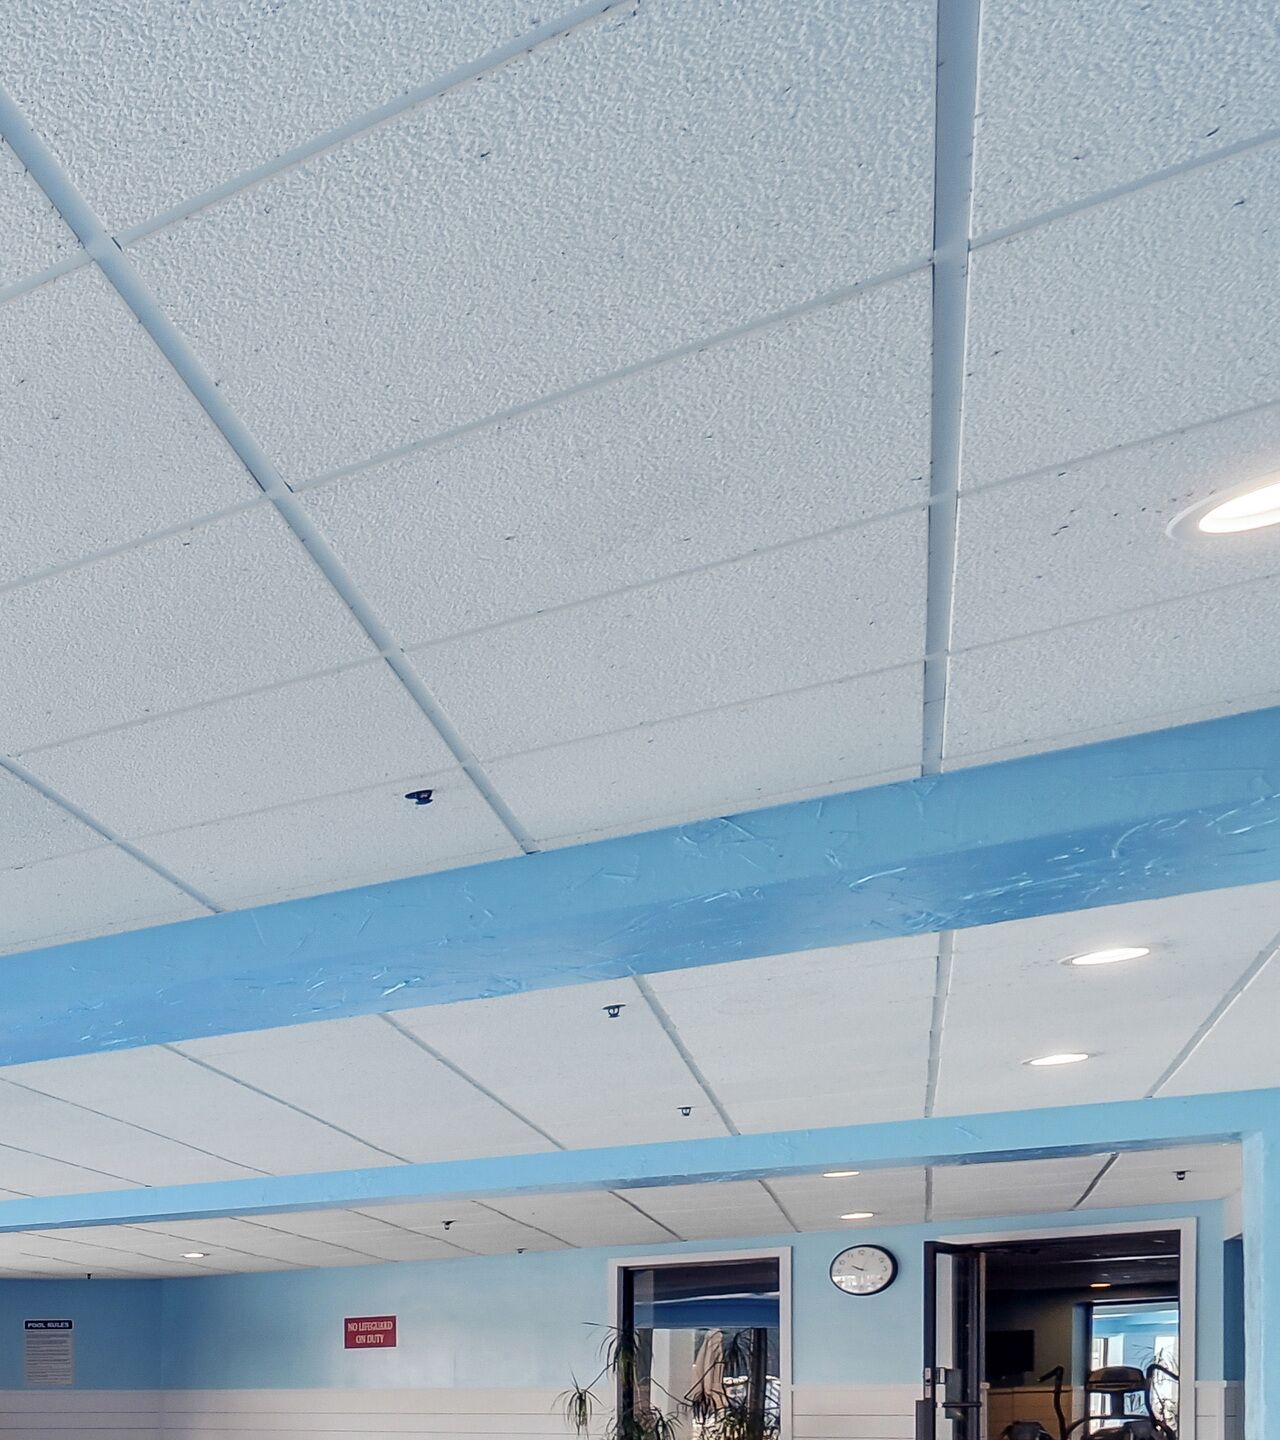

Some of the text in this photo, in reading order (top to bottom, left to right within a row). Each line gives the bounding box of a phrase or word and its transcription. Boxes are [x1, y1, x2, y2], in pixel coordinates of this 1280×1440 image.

[347, 1320, 393, 1332] NO LIFEGUARD
[355, 1333, 385, 1344] ON DUTY
